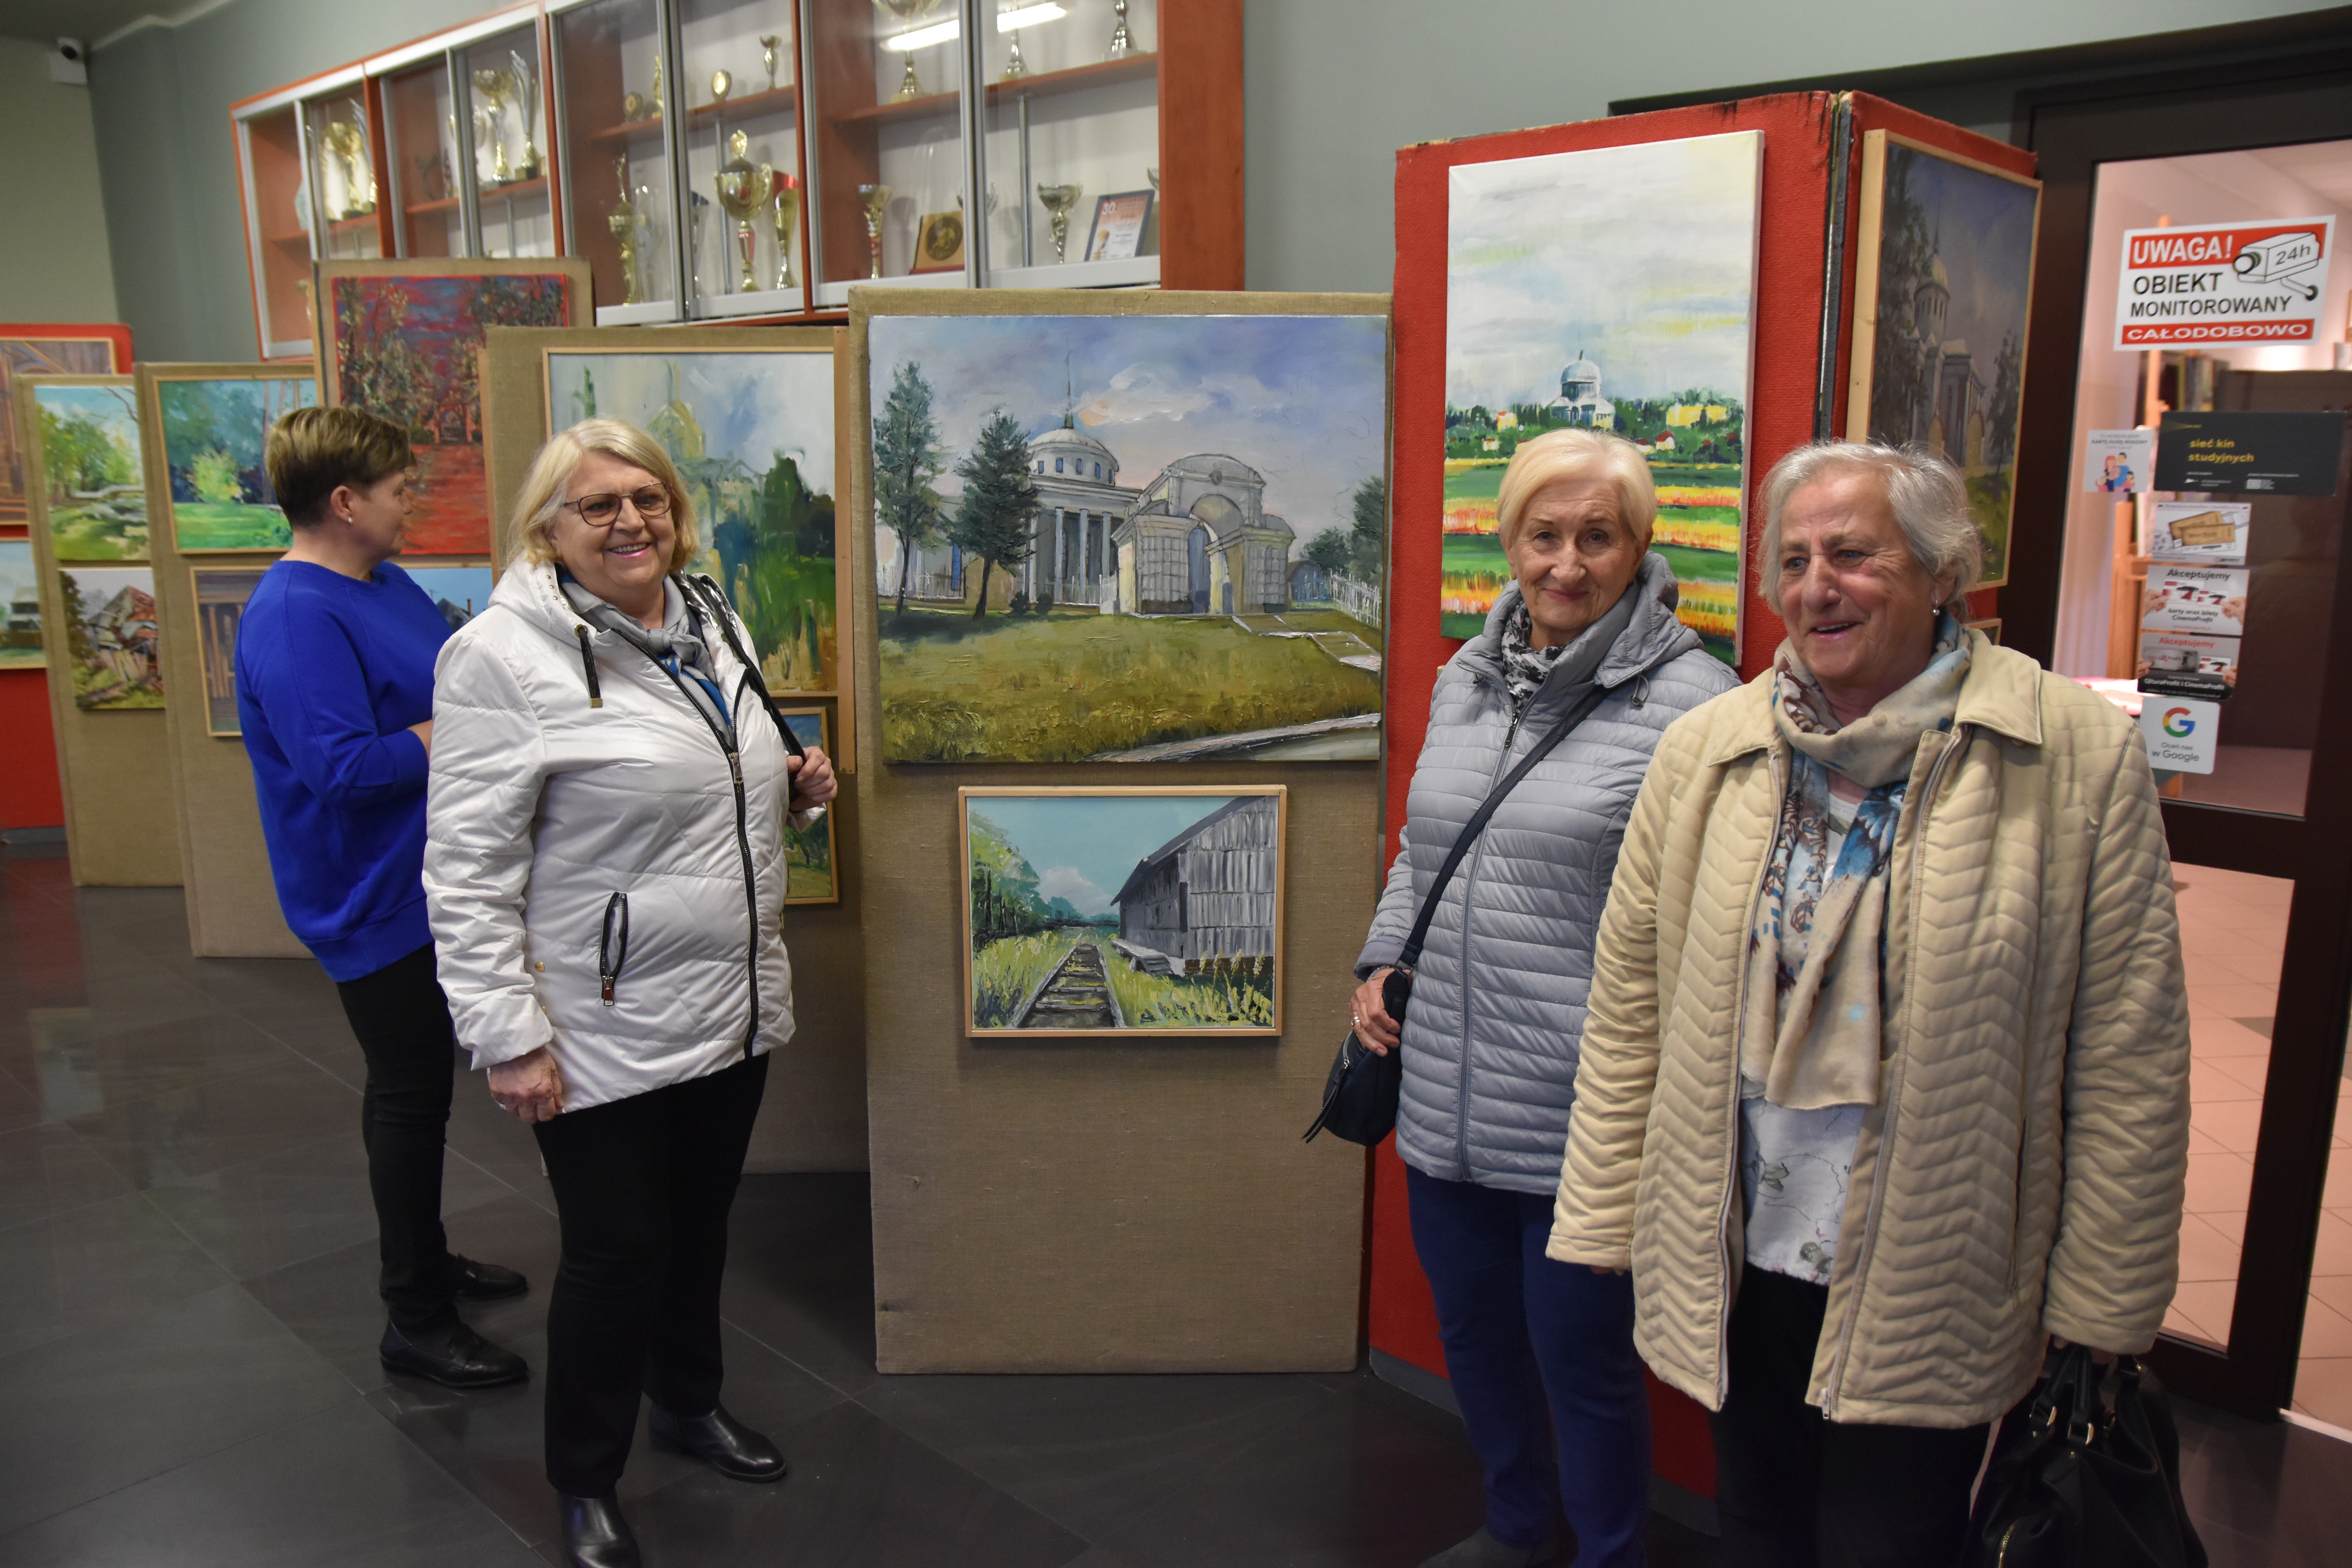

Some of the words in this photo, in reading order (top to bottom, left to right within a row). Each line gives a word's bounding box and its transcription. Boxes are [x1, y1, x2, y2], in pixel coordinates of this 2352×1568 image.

[2133, 234, 2234, 265] UWAGA!
[2275, 244, 2311, 266] 24h
[2134, 272, 2223, 295] OBIEKT
[2130, 296, 2292, 318] MONITOROWANY
[2127, 324, 2307, 340] CAŁODOBOWO
[2190, 438, 2214, 448] sieć
[2216, 439, 2235, 448] kin
[2188, 453, 2255, 464] studyjnych
[2167, 569, 2230, 581] Akceptujemy
[2159, 637, 2215, 649] Akceptujemy
[2163, 750, 2200, 762] Google
